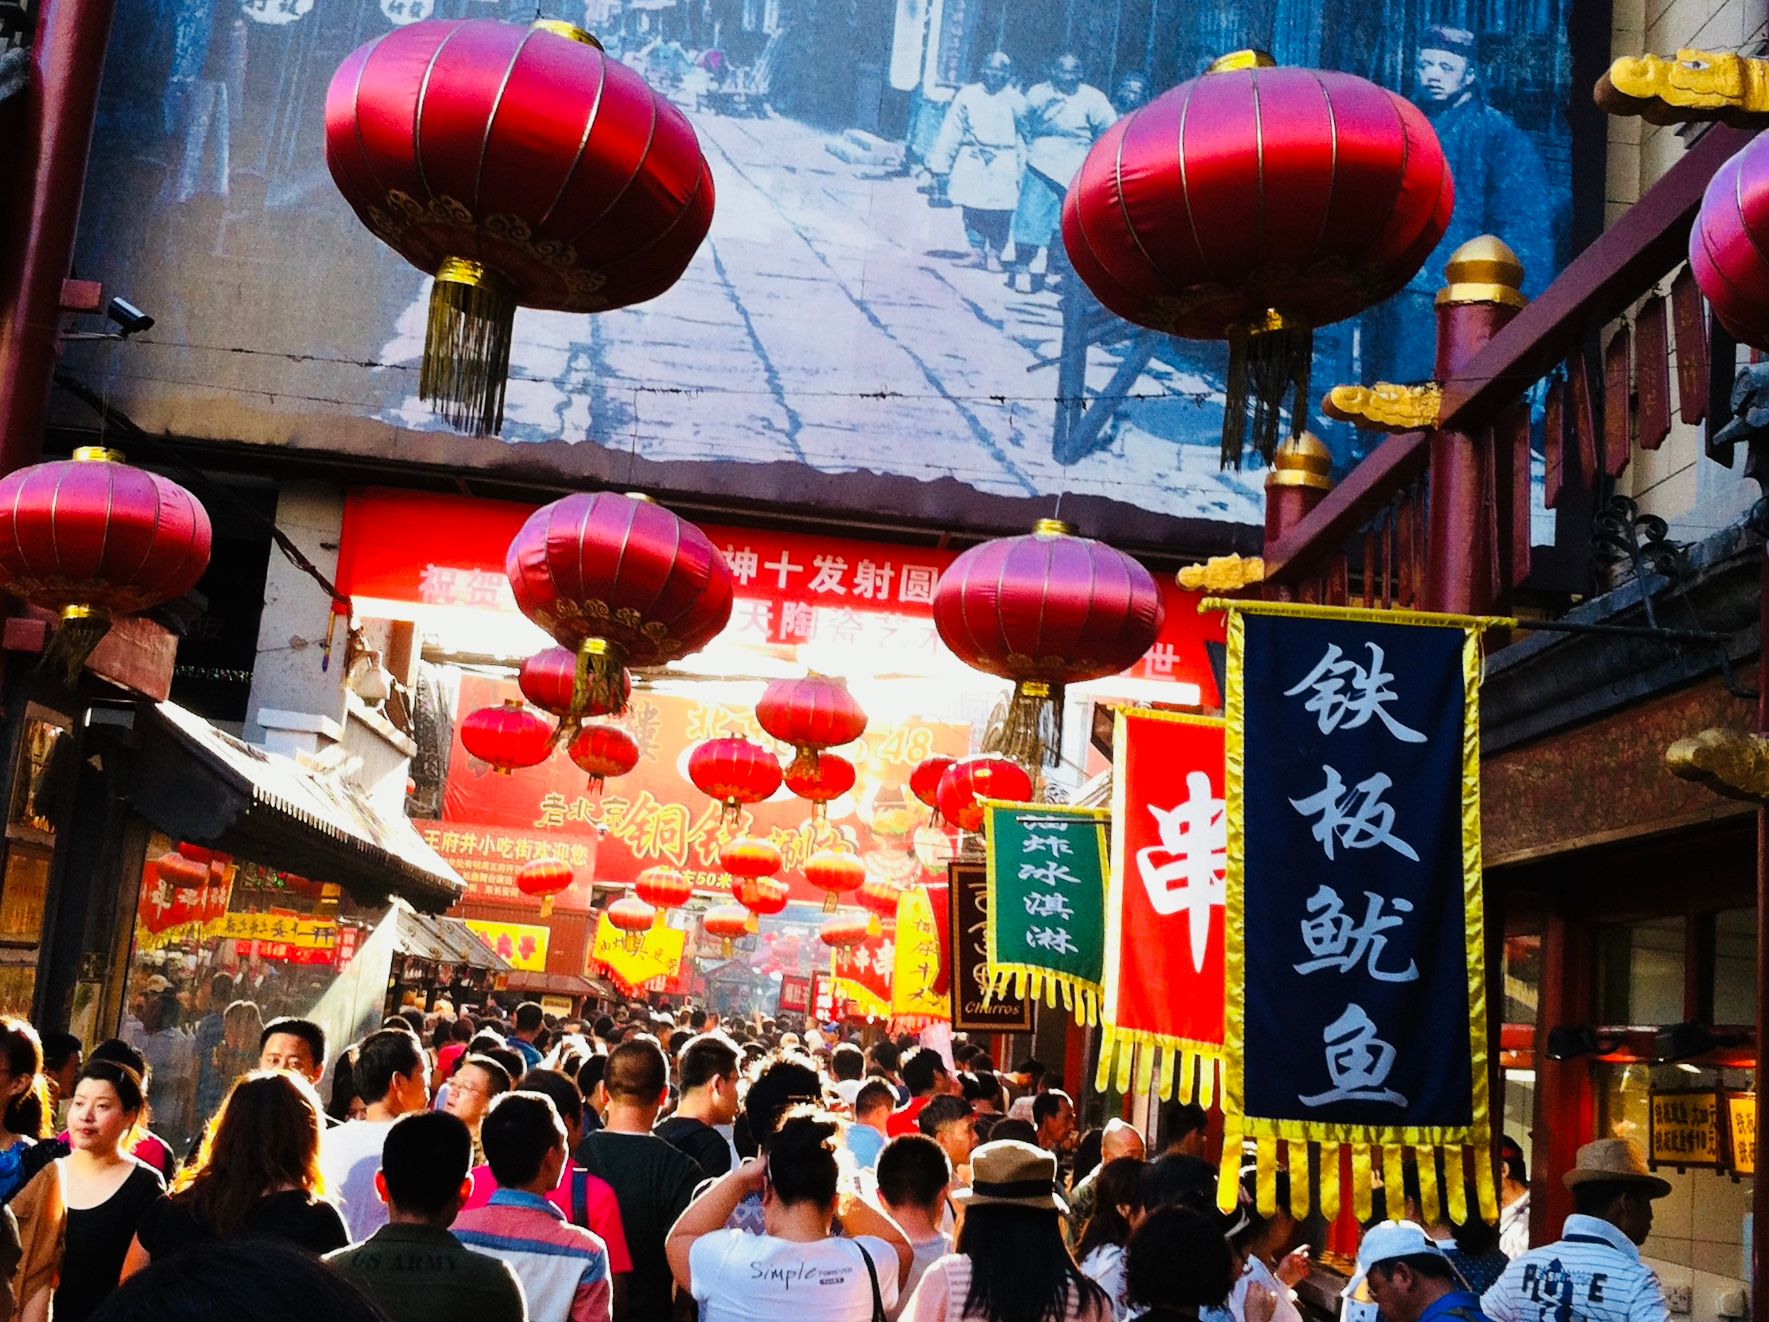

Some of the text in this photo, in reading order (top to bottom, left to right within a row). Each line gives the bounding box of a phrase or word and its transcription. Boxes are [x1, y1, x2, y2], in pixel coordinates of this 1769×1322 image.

[424, 829, 589, 867] 王府井小吃街欢迎您
[1136, 771, 1227, 973] 串
[1285, 642, 1428, 1108] 铁板鱿鱼
[750, 1261, 816, 1290] Simple
